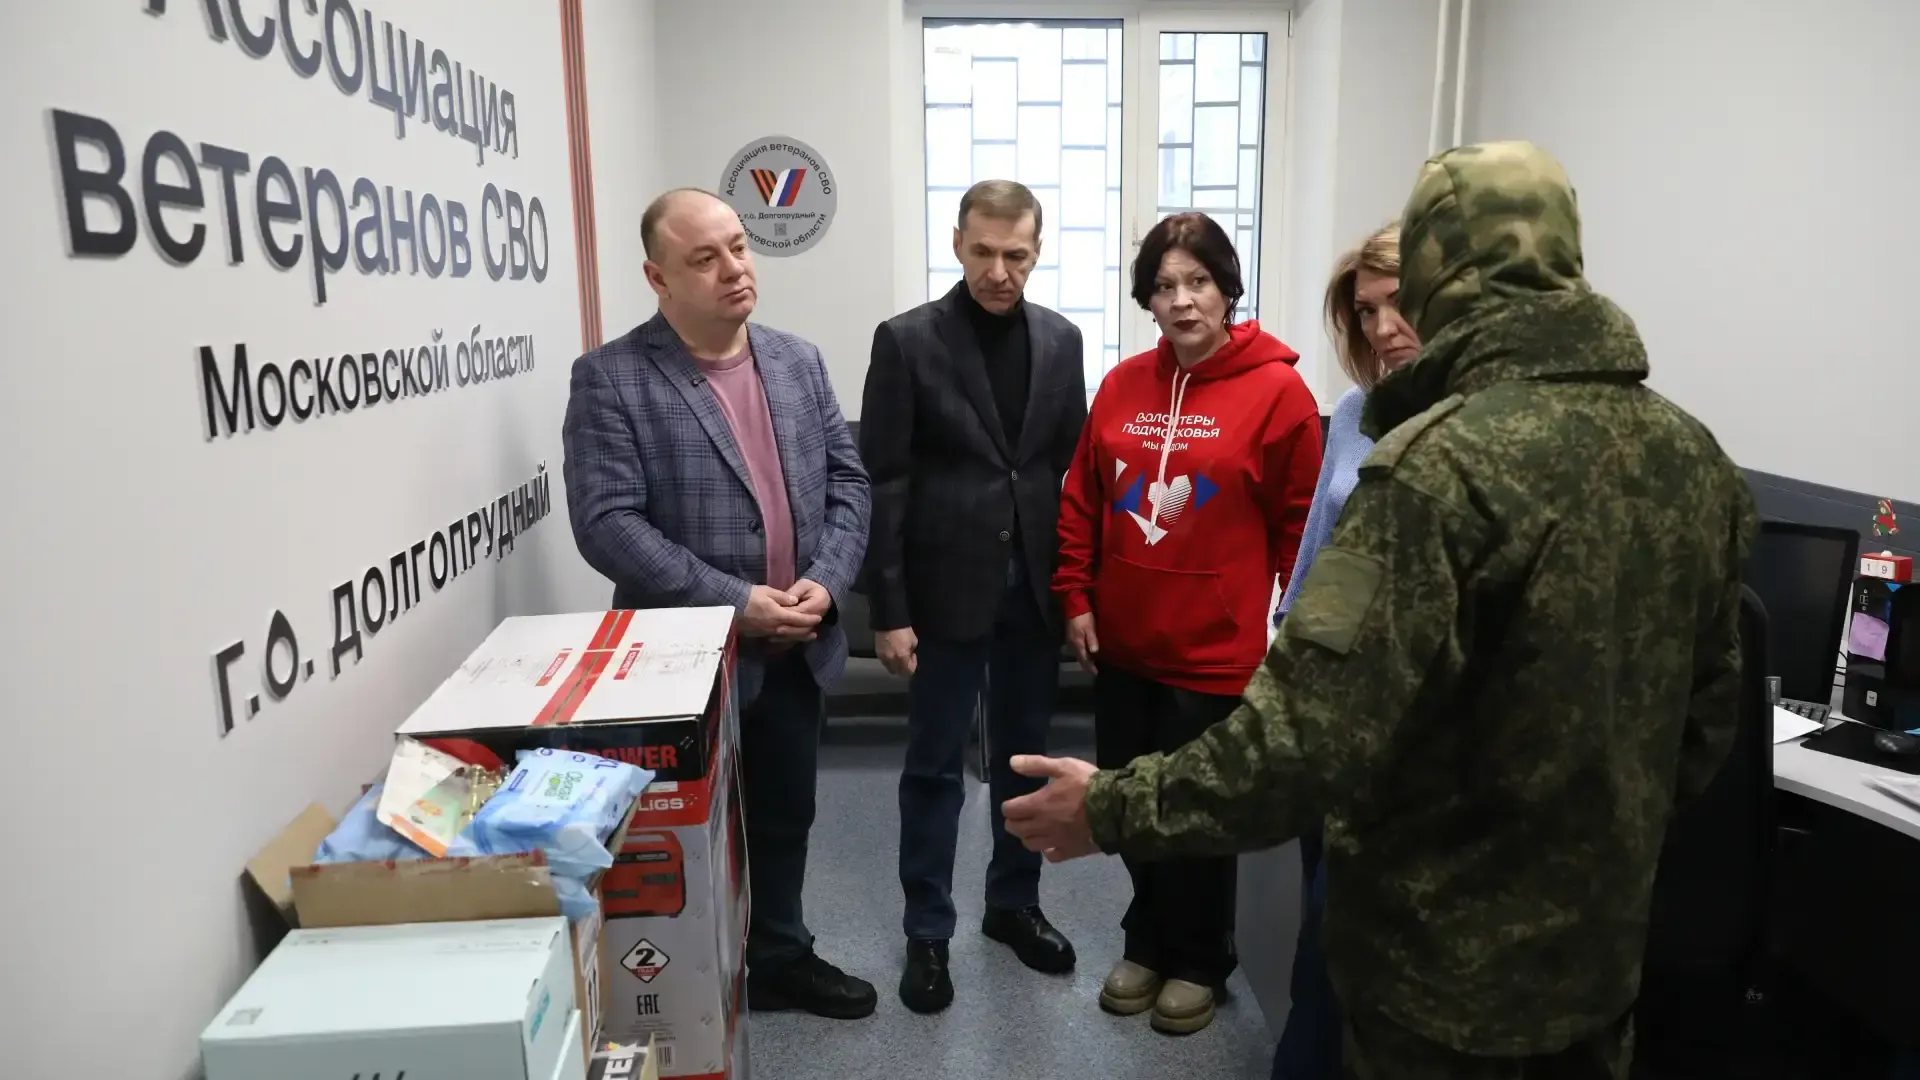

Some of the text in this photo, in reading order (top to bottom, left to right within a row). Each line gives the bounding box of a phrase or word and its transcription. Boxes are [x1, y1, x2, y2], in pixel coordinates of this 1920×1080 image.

[143, 0, 519, 166] ссоциация
[726, 143, 832, 196] Ассоциация ветеранов СВО
[481, 183, 549, 283] СВО
[758, 212, 816, 220] Долгопрудный
[793, 213, 826, 246] области
[197, 324, 535, 442] Московской области
[1135, 412, 1216, 426] ВОЛОТЕРЫ
[330, 460, 551, 680] ДОЛГОПРУДНЫЙ
[635, 948, 656, 967] 2
[636, 994, 660, 1015] EAC
